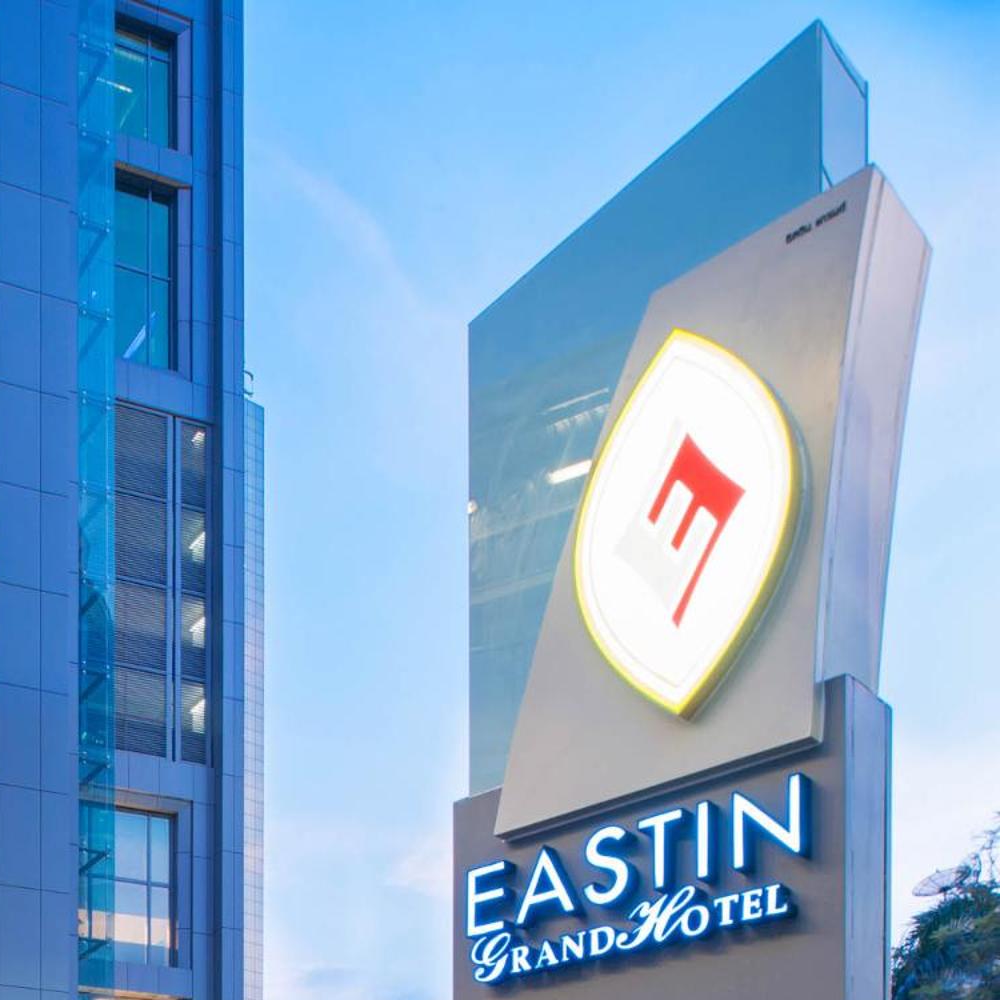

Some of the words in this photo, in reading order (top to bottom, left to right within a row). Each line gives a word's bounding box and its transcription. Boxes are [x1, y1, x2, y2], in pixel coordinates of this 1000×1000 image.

[466, 772, 808, 937] EASTIN
[471, 922, 616, 982] GRAND
[616, 884, 792, 950] HOTEL
